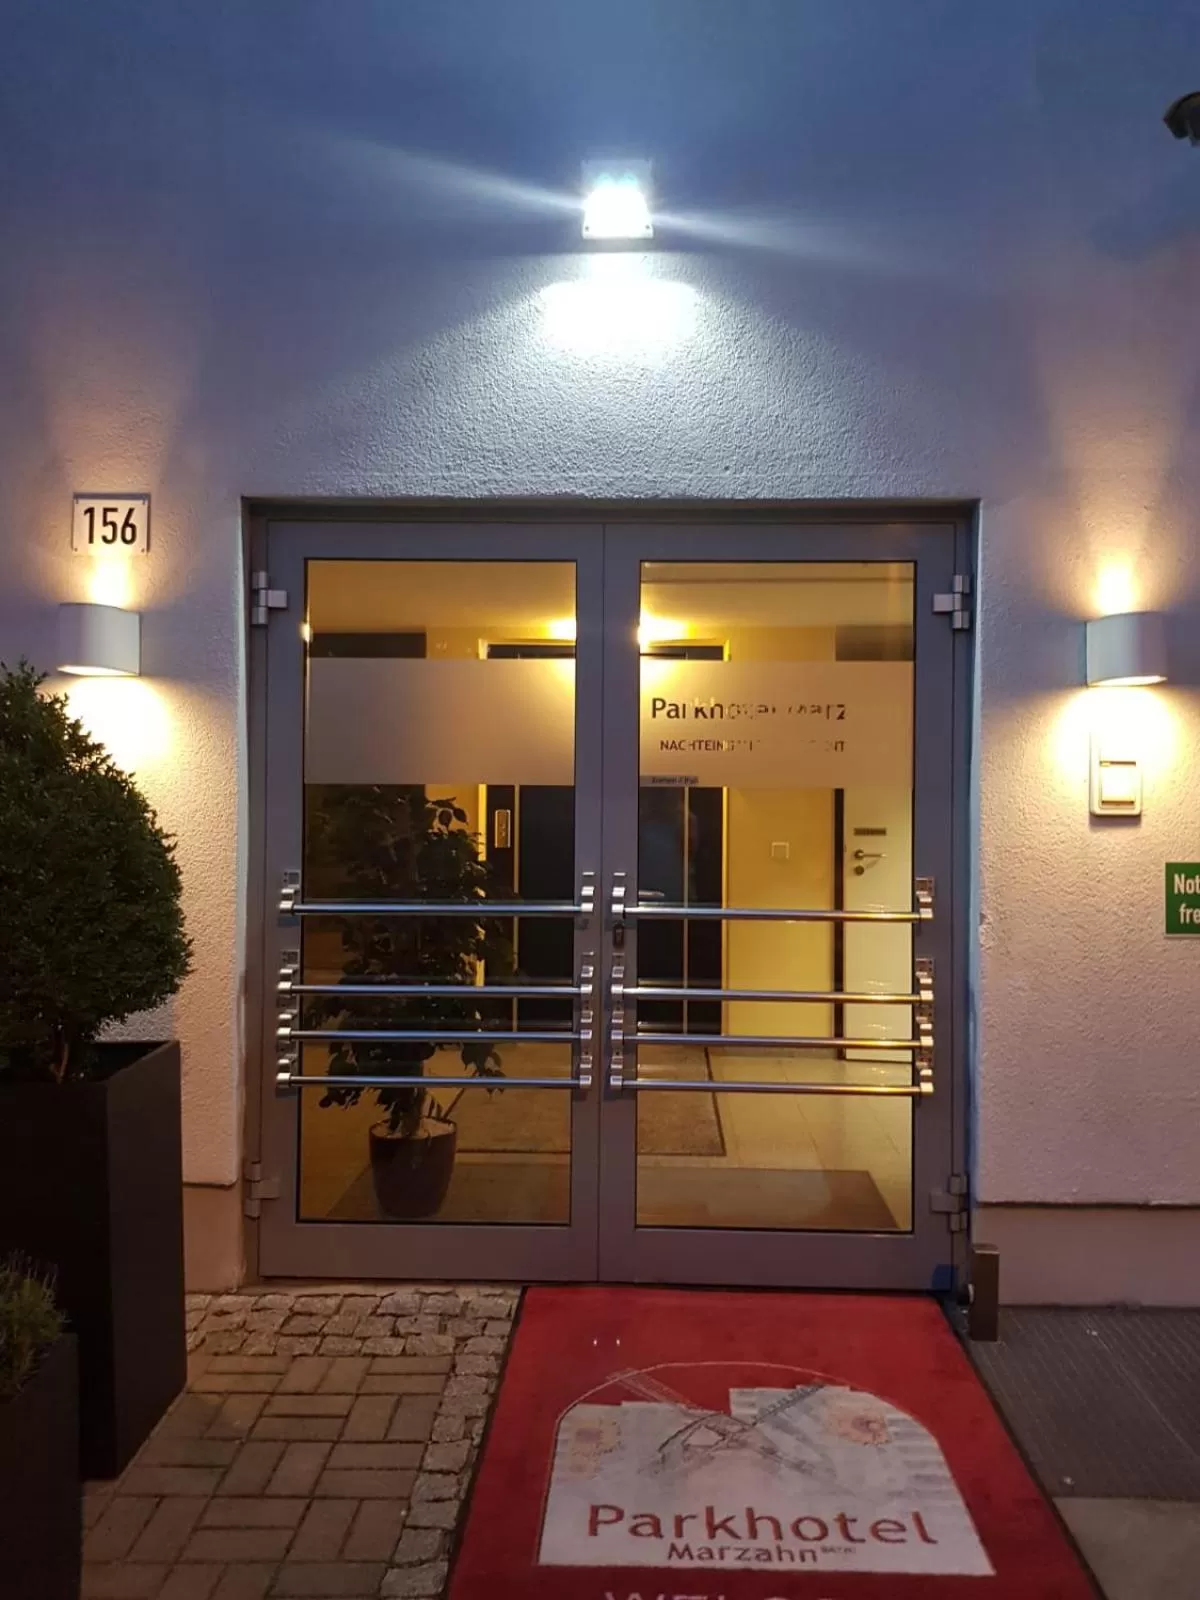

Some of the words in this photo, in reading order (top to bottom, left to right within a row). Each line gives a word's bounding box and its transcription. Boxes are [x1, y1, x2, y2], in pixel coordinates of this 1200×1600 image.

[83, 506, 138, 545] 156
[1173, 872, 1200, 895] Not
[587, 1504, 938, 1545] Parkhotel
[666, 1541, 819, 1564] Marzahn
